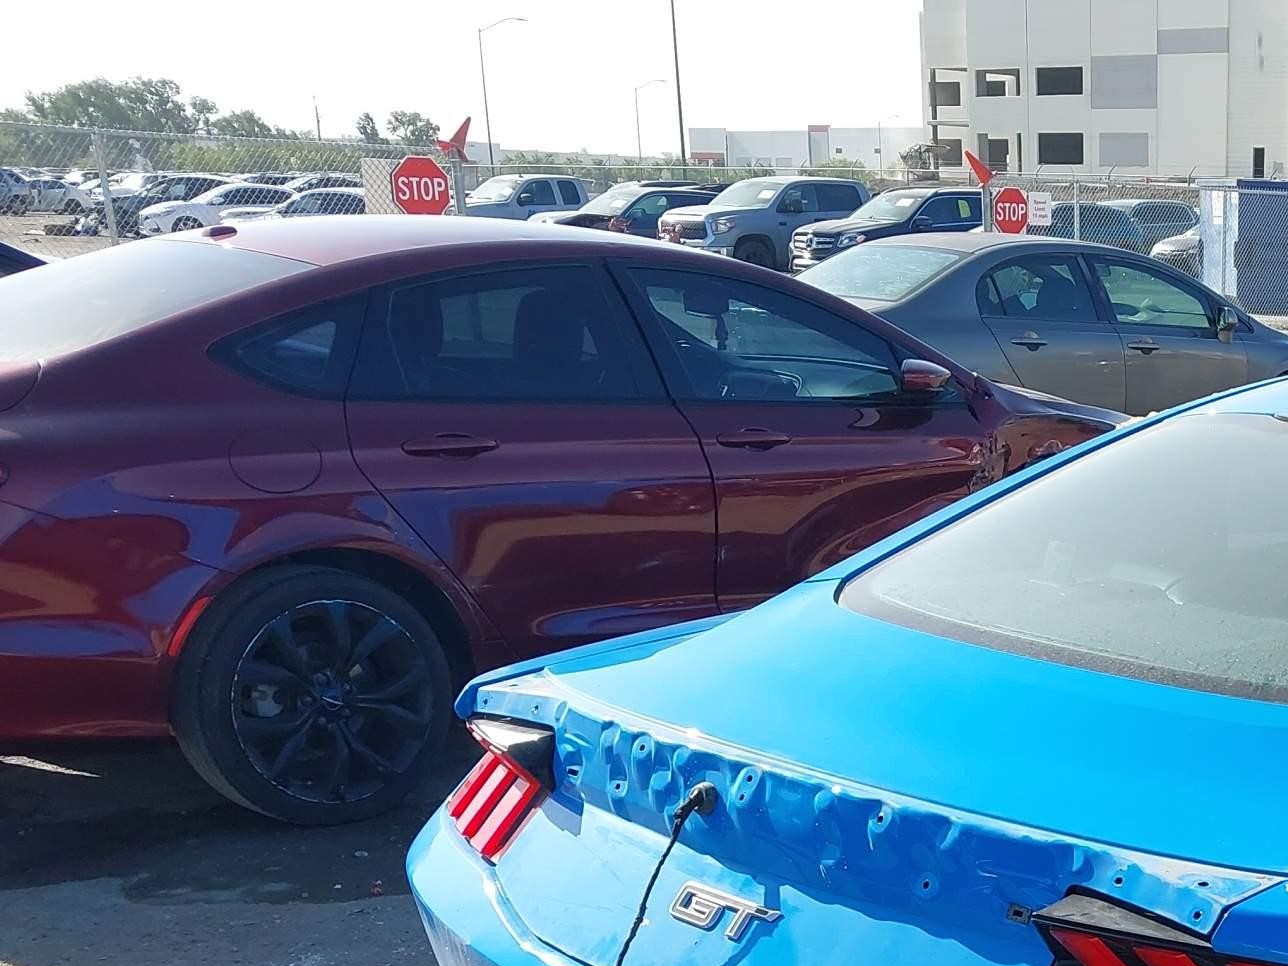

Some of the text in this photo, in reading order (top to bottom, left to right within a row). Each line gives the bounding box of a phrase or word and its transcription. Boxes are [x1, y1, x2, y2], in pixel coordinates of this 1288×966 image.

[398, 176, 445, 201] STOP
[996, 202, 1026, 221] STOP
[669, 880, 785, 943] GT
